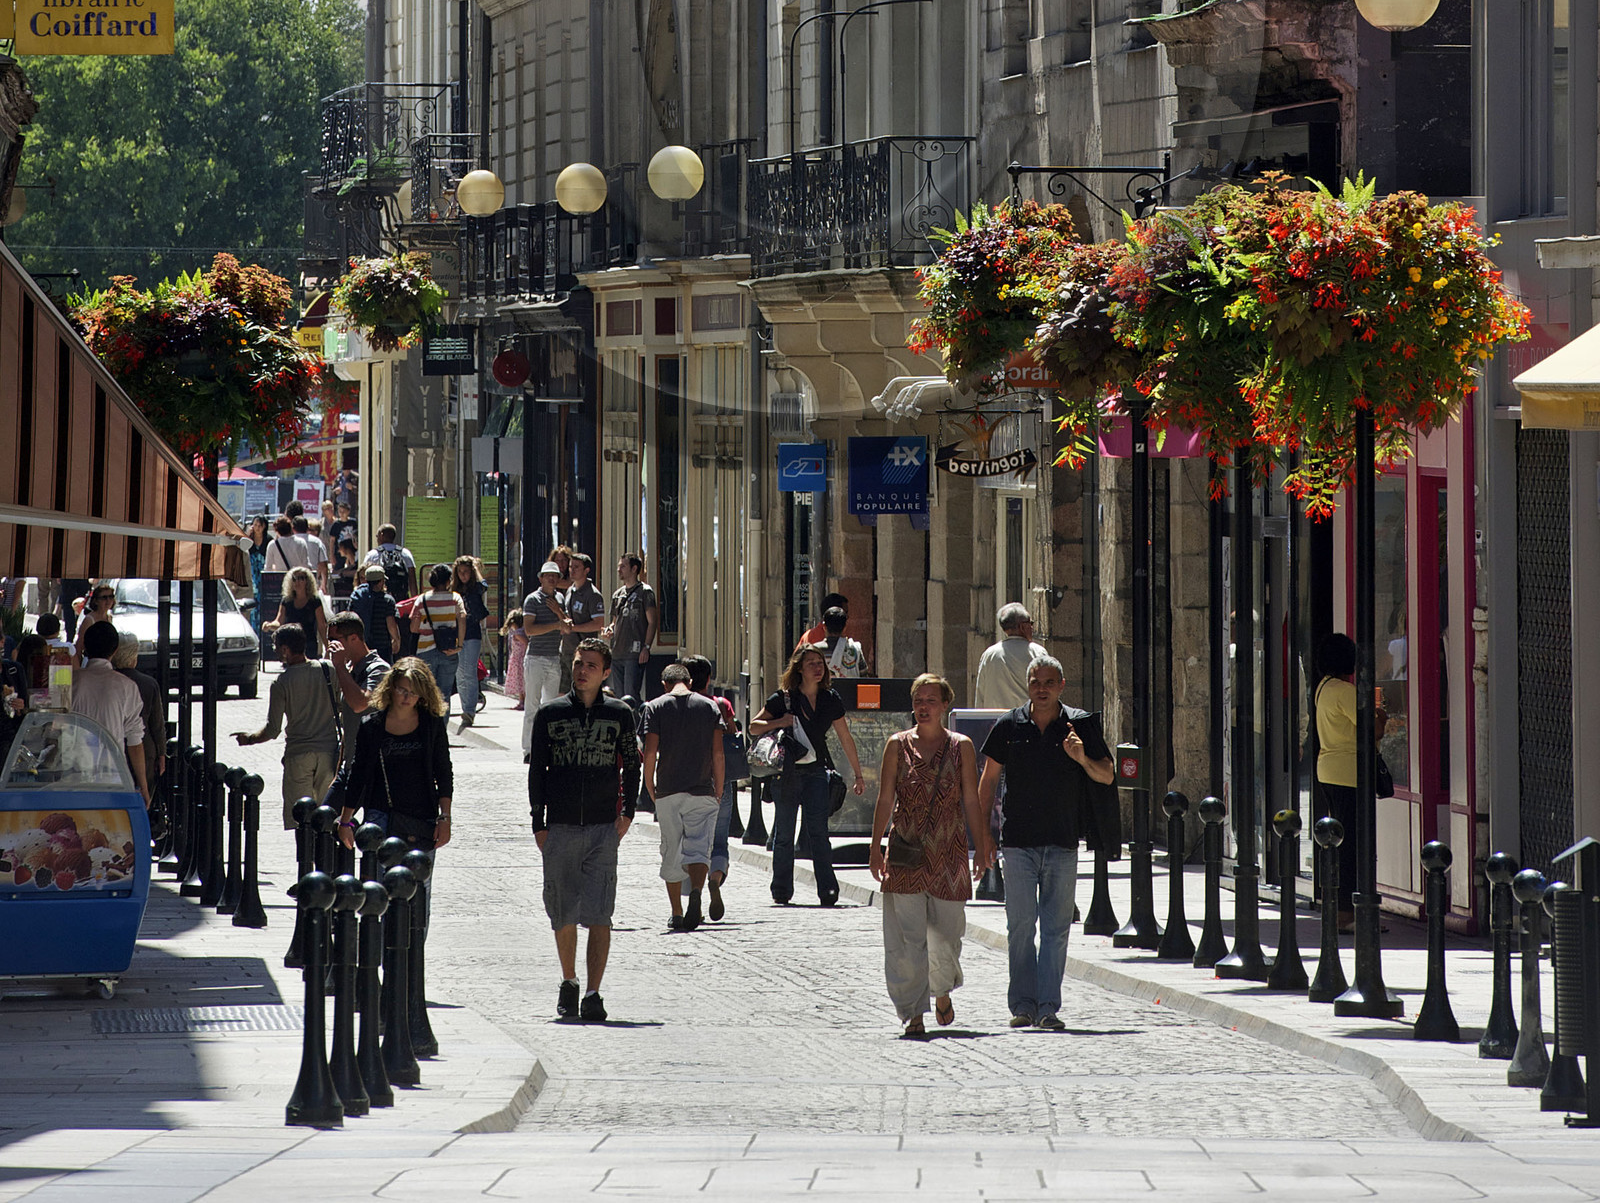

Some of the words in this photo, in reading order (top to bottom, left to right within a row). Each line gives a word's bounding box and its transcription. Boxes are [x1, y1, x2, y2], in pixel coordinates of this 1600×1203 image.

[29, 11, 159, 38] Coiffard
[948, 450, 1027, 476] berlingot
[857, 493, 920, 501] BANQUE
[858, 701, 880, 709] orange
